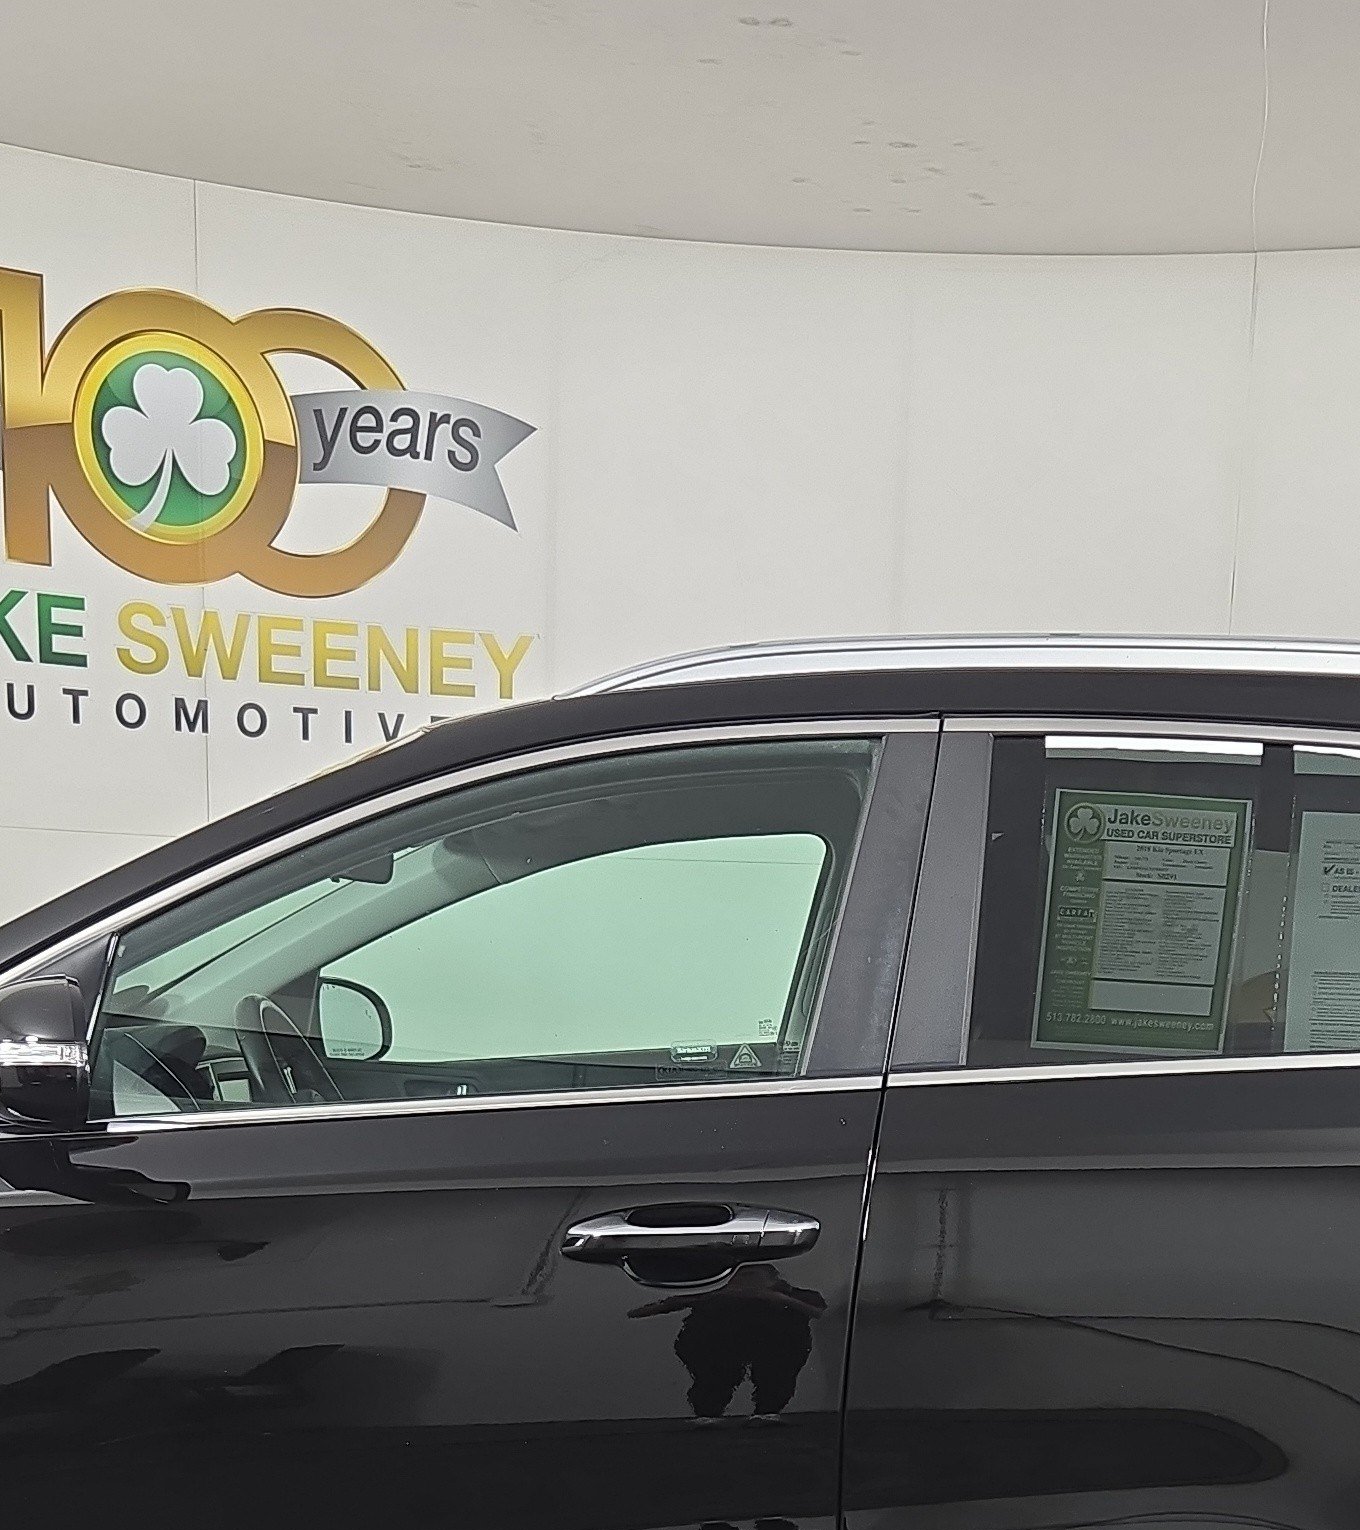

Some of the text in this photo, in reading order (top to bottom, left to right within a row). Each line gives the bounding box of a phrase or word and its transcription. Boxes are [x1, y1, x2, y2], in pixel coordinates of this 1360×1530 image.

[312, 403, 482, 473] years
[115, 601, 538, 701] SWEENEY
[1106, 827, 1233, 846] USED CAR SUPERSTORE
[1334, 867, 1345, 875] AS
